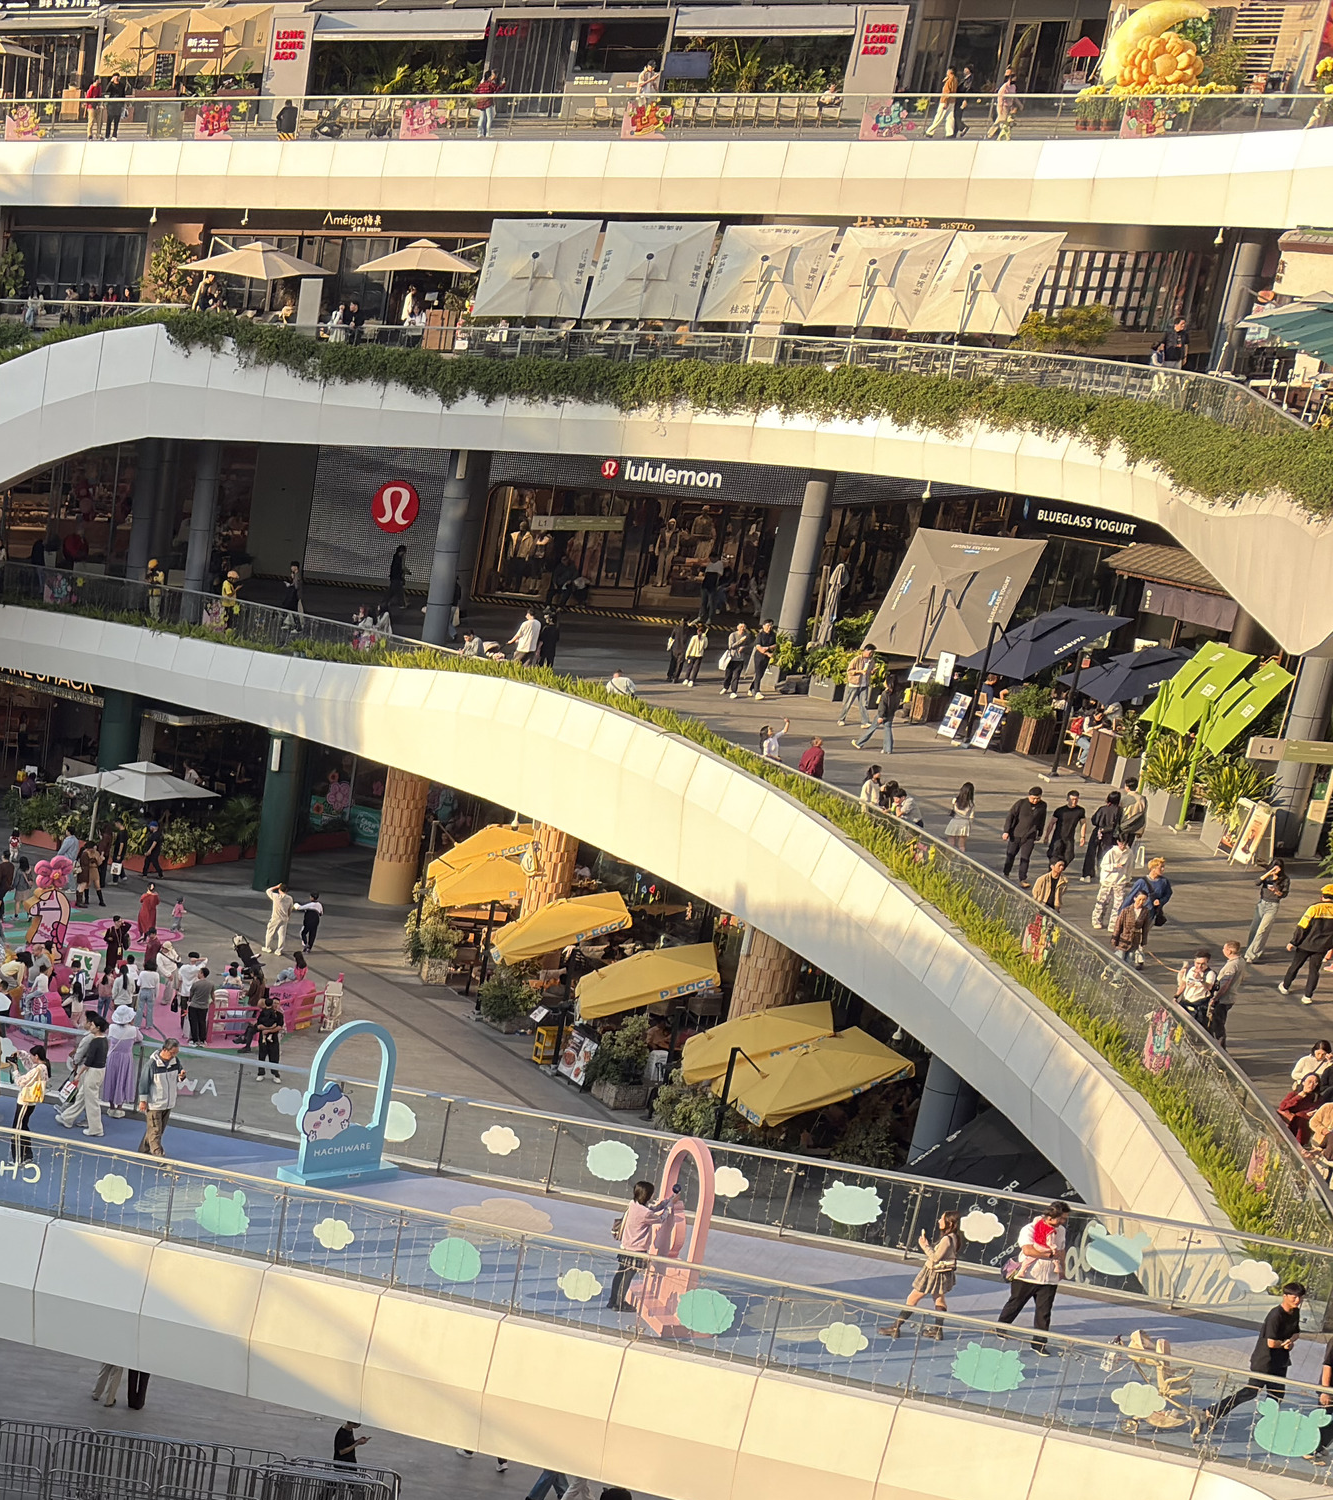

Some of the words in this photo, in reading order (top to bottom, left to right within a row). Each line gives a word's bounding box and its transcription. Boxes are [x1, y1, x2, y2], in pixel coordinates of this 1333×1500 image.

[865, 23, 898, 34] LONG
[276, 29, 304, 40] LONG
[862, 34, 896, 45] LONG
[274, 39, 304, 50] LONG
[861, 45, 887, 55] AGO
[273, 50, 297, 61] AGO
[624, 459, 723, 489] lululemon
[1037, 508, 1093, 529] BLUEGLASS
[1094, 517, 1137, 536] YOGURT
[1053, 634, 1087, 655] AZABUYA
[1259, 745, 1272, 755] L1
[313, 1142, 371, 1158] HACHIWARE
[986, 1179, 1020, 1207] gga
